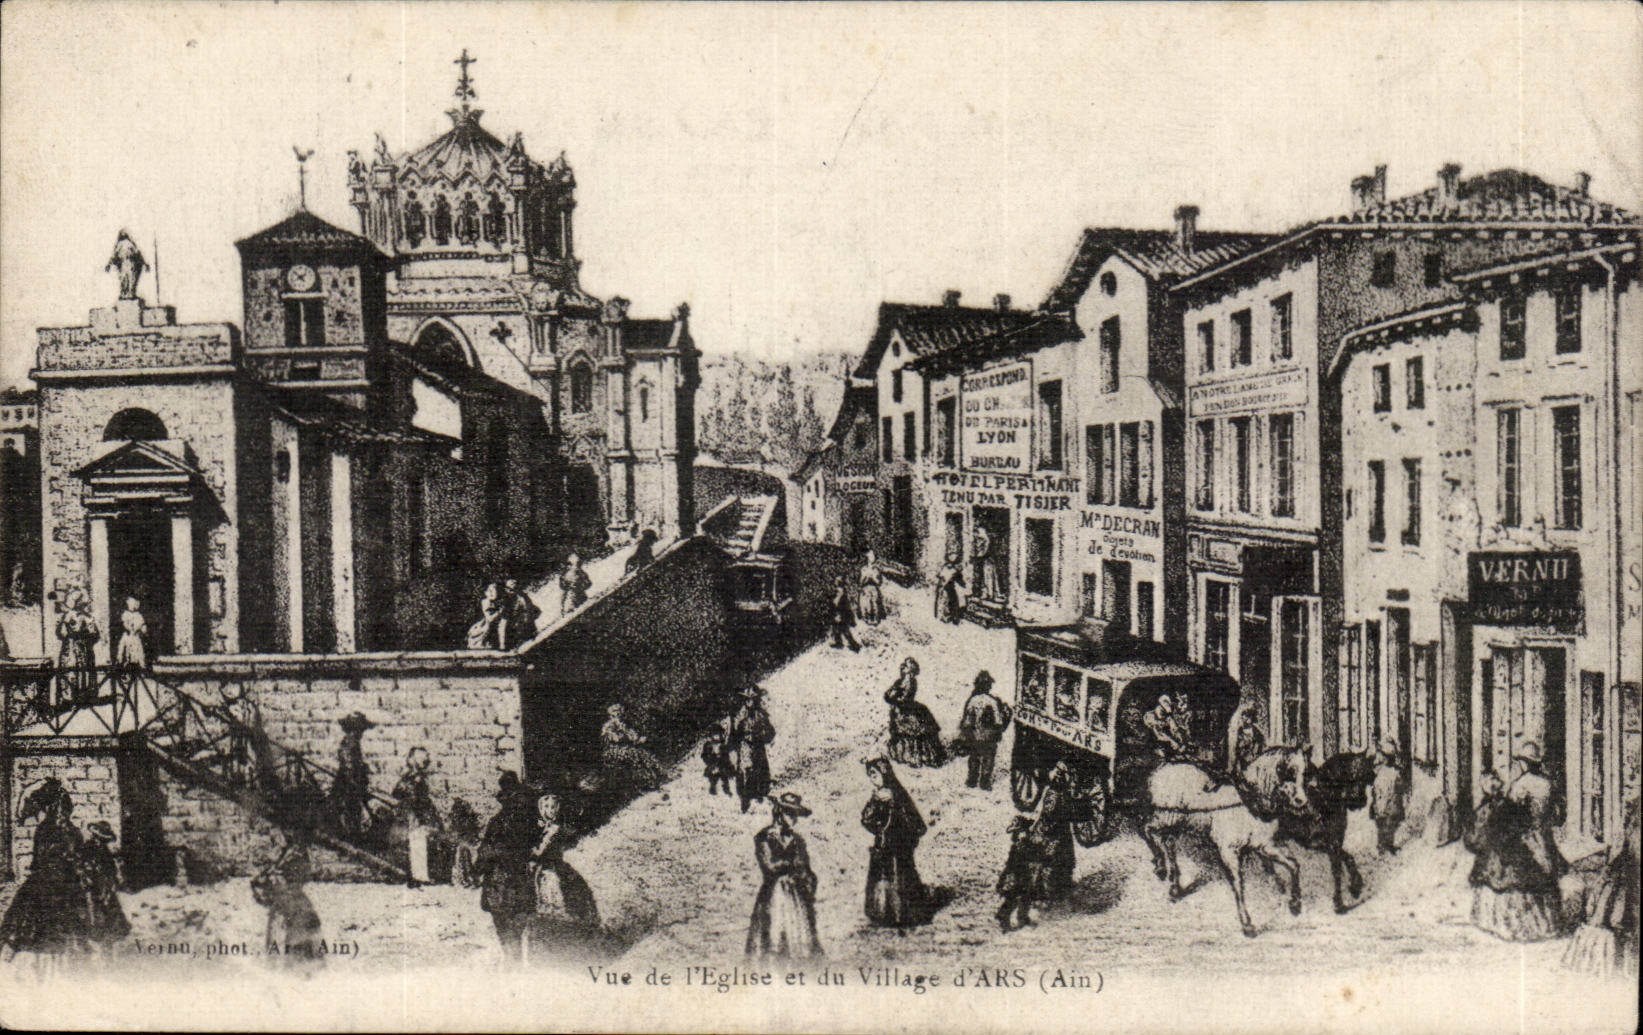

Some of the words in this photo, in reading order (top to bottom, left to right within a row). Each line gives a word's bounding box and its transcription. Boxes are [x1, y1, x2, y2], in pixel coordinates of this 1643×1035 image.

[984, 416, 1020, 428] PARIS
[976, 430, 1017, 443] LYON
[970, 456, 1021, 468] BUREAU
[941, 490, 975, 504] TENU
[977, 492, 1006, 505] PAR
[1088, 540, 1103, 554] de
[1479, 559, 1569, 583] VERNU
[1072, 728, 1102, 752] ARS
